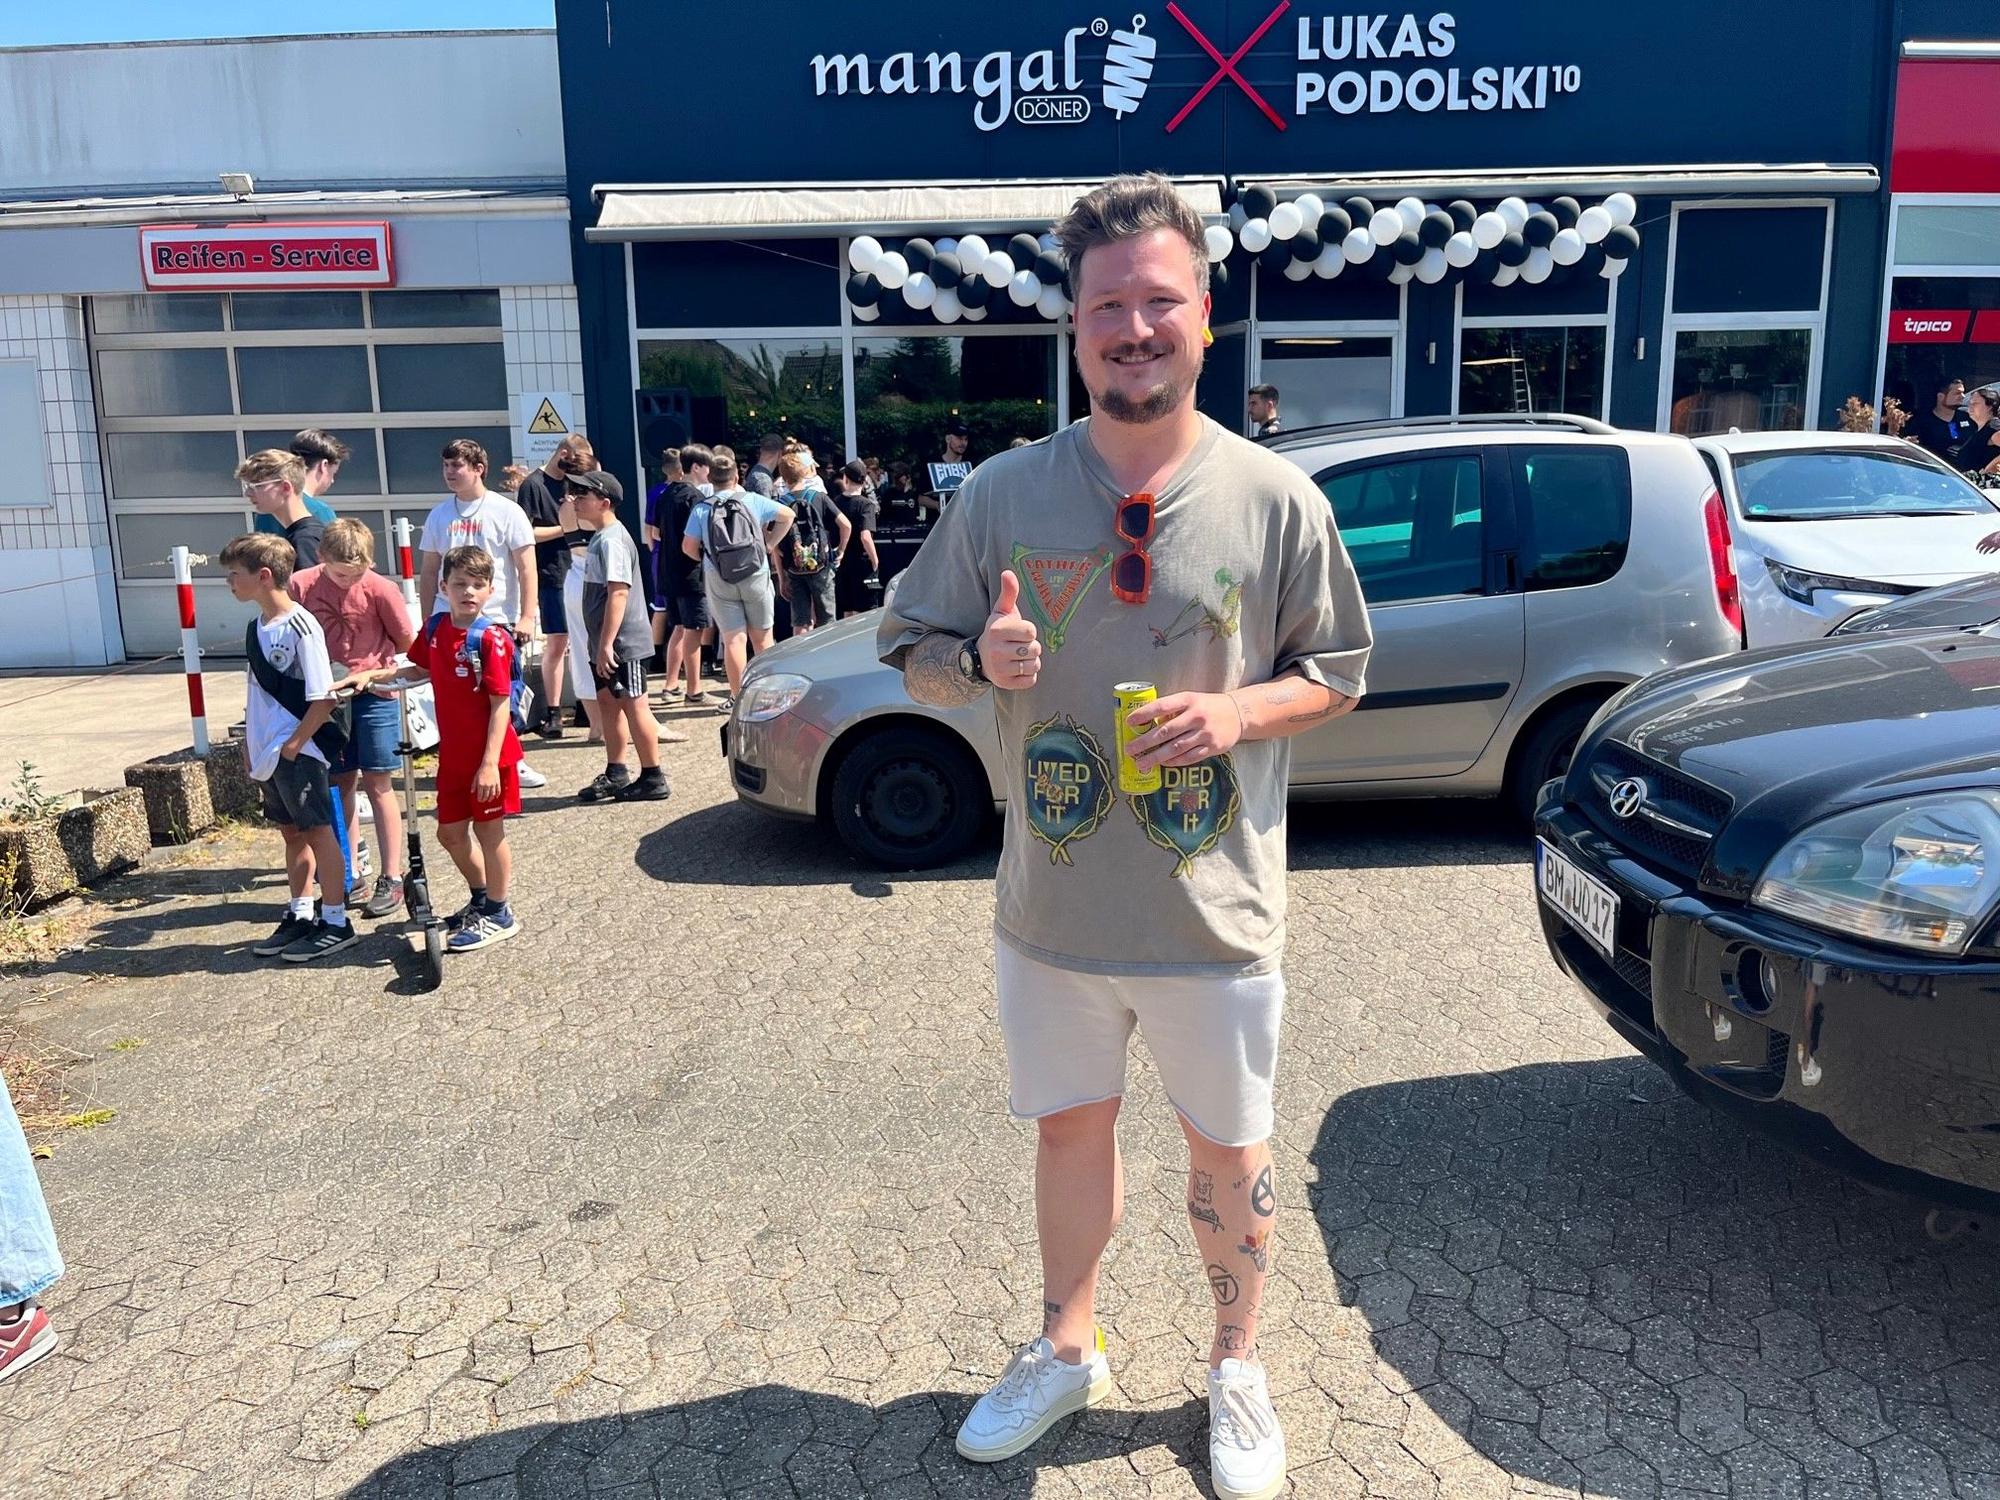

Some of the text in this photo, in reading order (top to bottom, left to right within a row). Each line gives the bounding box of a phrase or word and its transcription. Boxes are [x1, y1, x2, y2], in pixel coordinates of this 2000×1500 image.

[1298, 12, 1456, 60] LUKAS
[809, 27, 1088, 131] mangal
[1296, 66, 1548, 115] PODOLSKI
[1022, 98, 1083, 119] DÖNER
[156, 245, 246, 268] Reifen
[269, 242, 373, 267] Service
[1904, 317, 1952, 335] tipico
[1027, 758, 1091, 783] LIVED
[1164, 766, 1214, 788] DIED
[1167, 789, 1210, 811] FR
[1046, 805, 1066, 824] IT
[1546, 853, 1564, 902] BM
